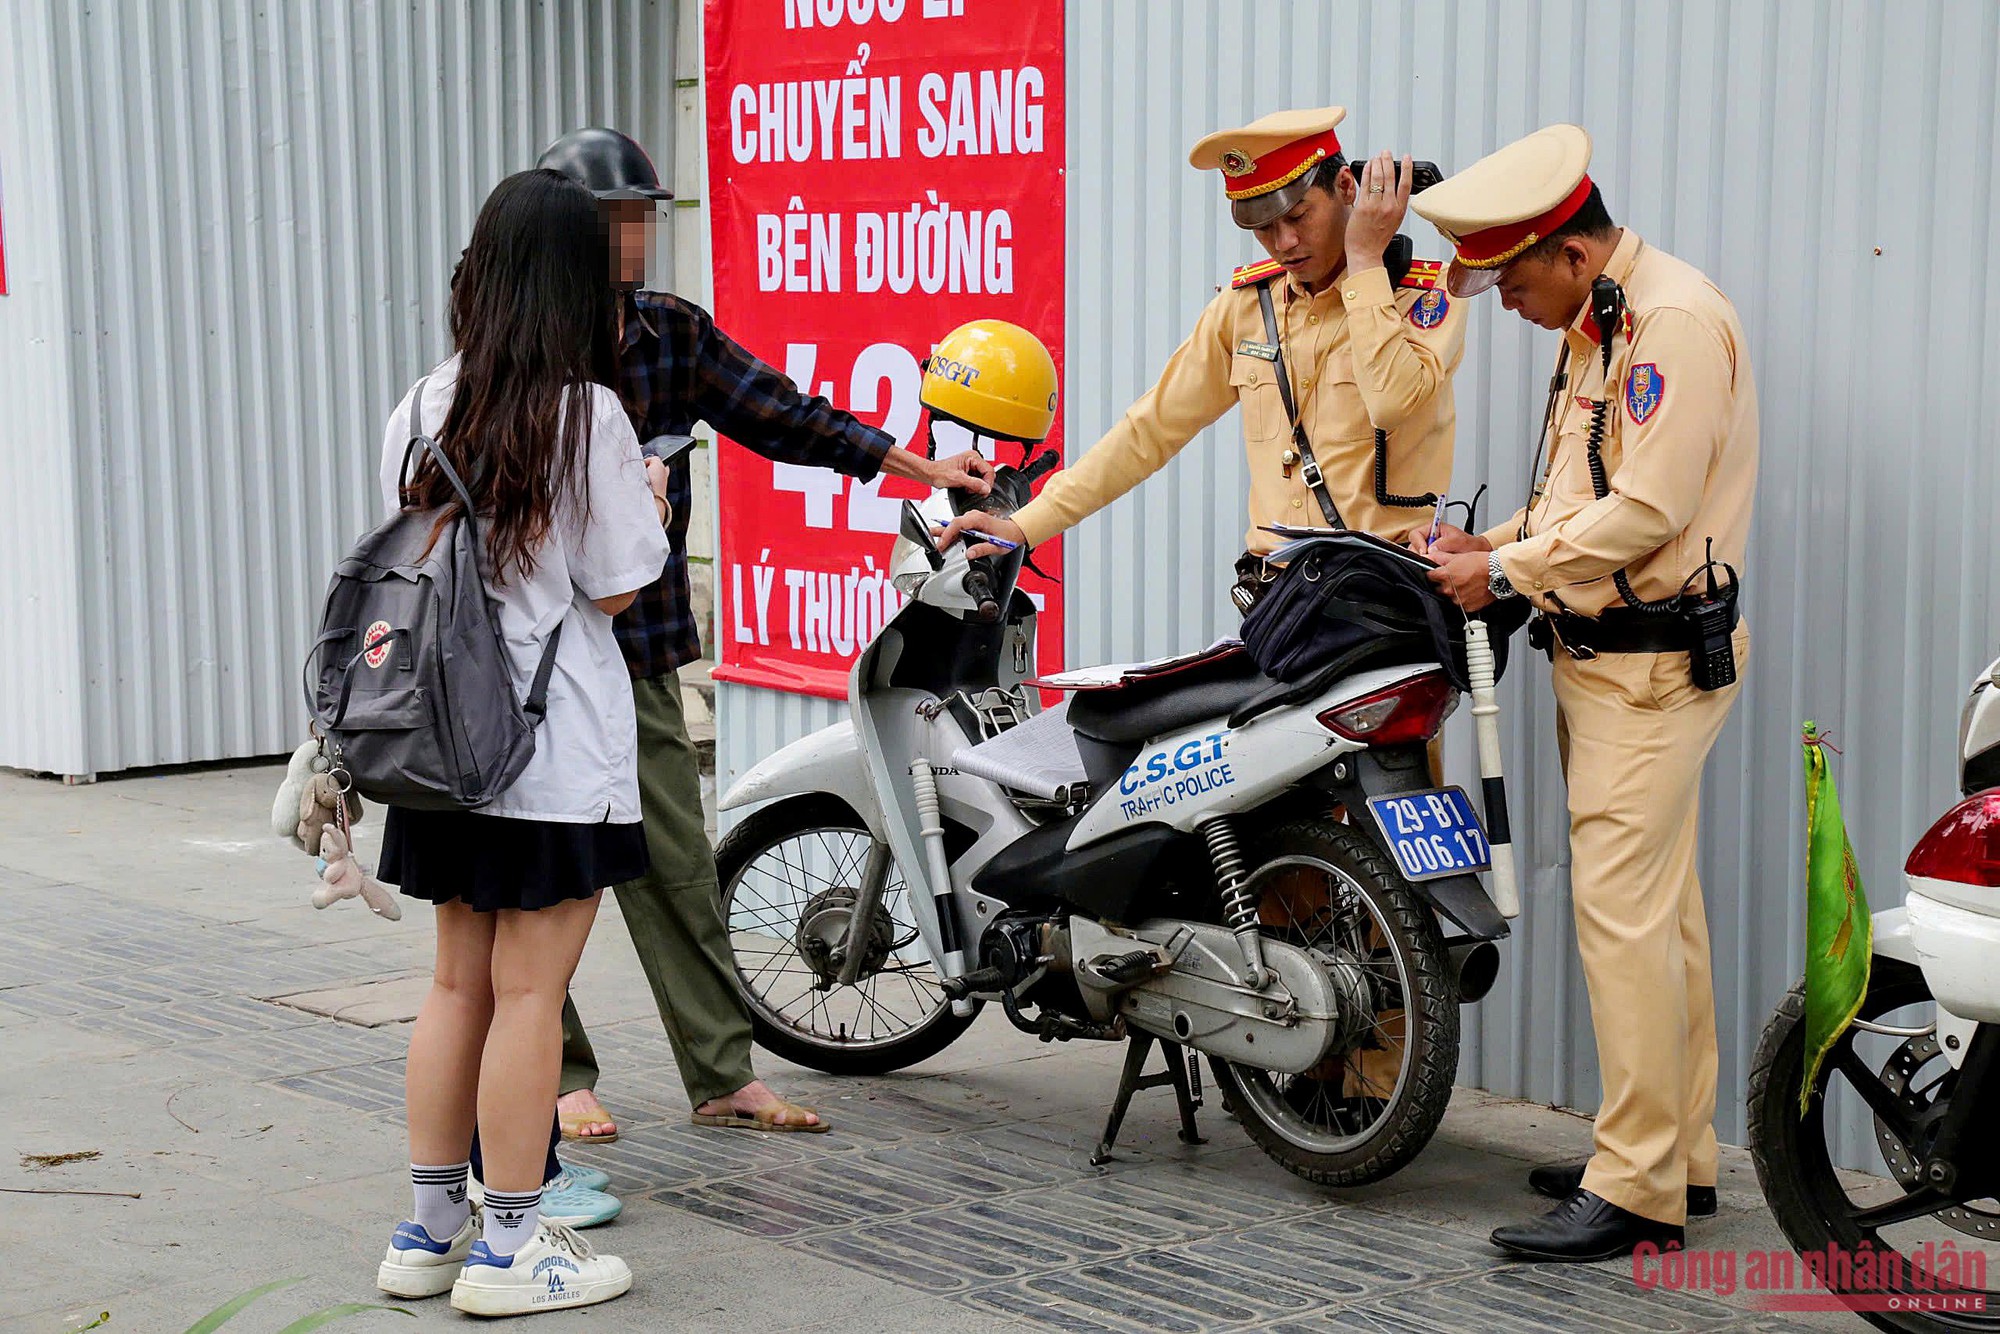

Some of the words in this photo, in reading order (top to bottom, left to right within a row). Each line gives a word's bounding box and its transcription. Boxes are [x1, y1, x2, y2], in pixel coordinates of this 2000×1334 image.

[730, 42, 900, 164] CHUYỂN
[917, 66, 1044, 158] SANG
[756, 196, 841, 293] BÊN
[854, 190, 1013, 294] ĐƯỜNG
[929, 355, 980, 387] CSGT
[732, 548, 775, 646] LÝ
[908, 766, 960, 776] NDA
[1120, 730, 1232, 796] C.S.G.T
[1175, 764, 1235, 800] POLICE
[1386, 793, 1464, 834] 29-B1
[1398, 829, 1486, 873] 006.17
[532, 1255, 580, 1281] DODGERS
[532, 1294, 546, 1304] LOS
[547, 1290, 580, 1302] ANGELES
